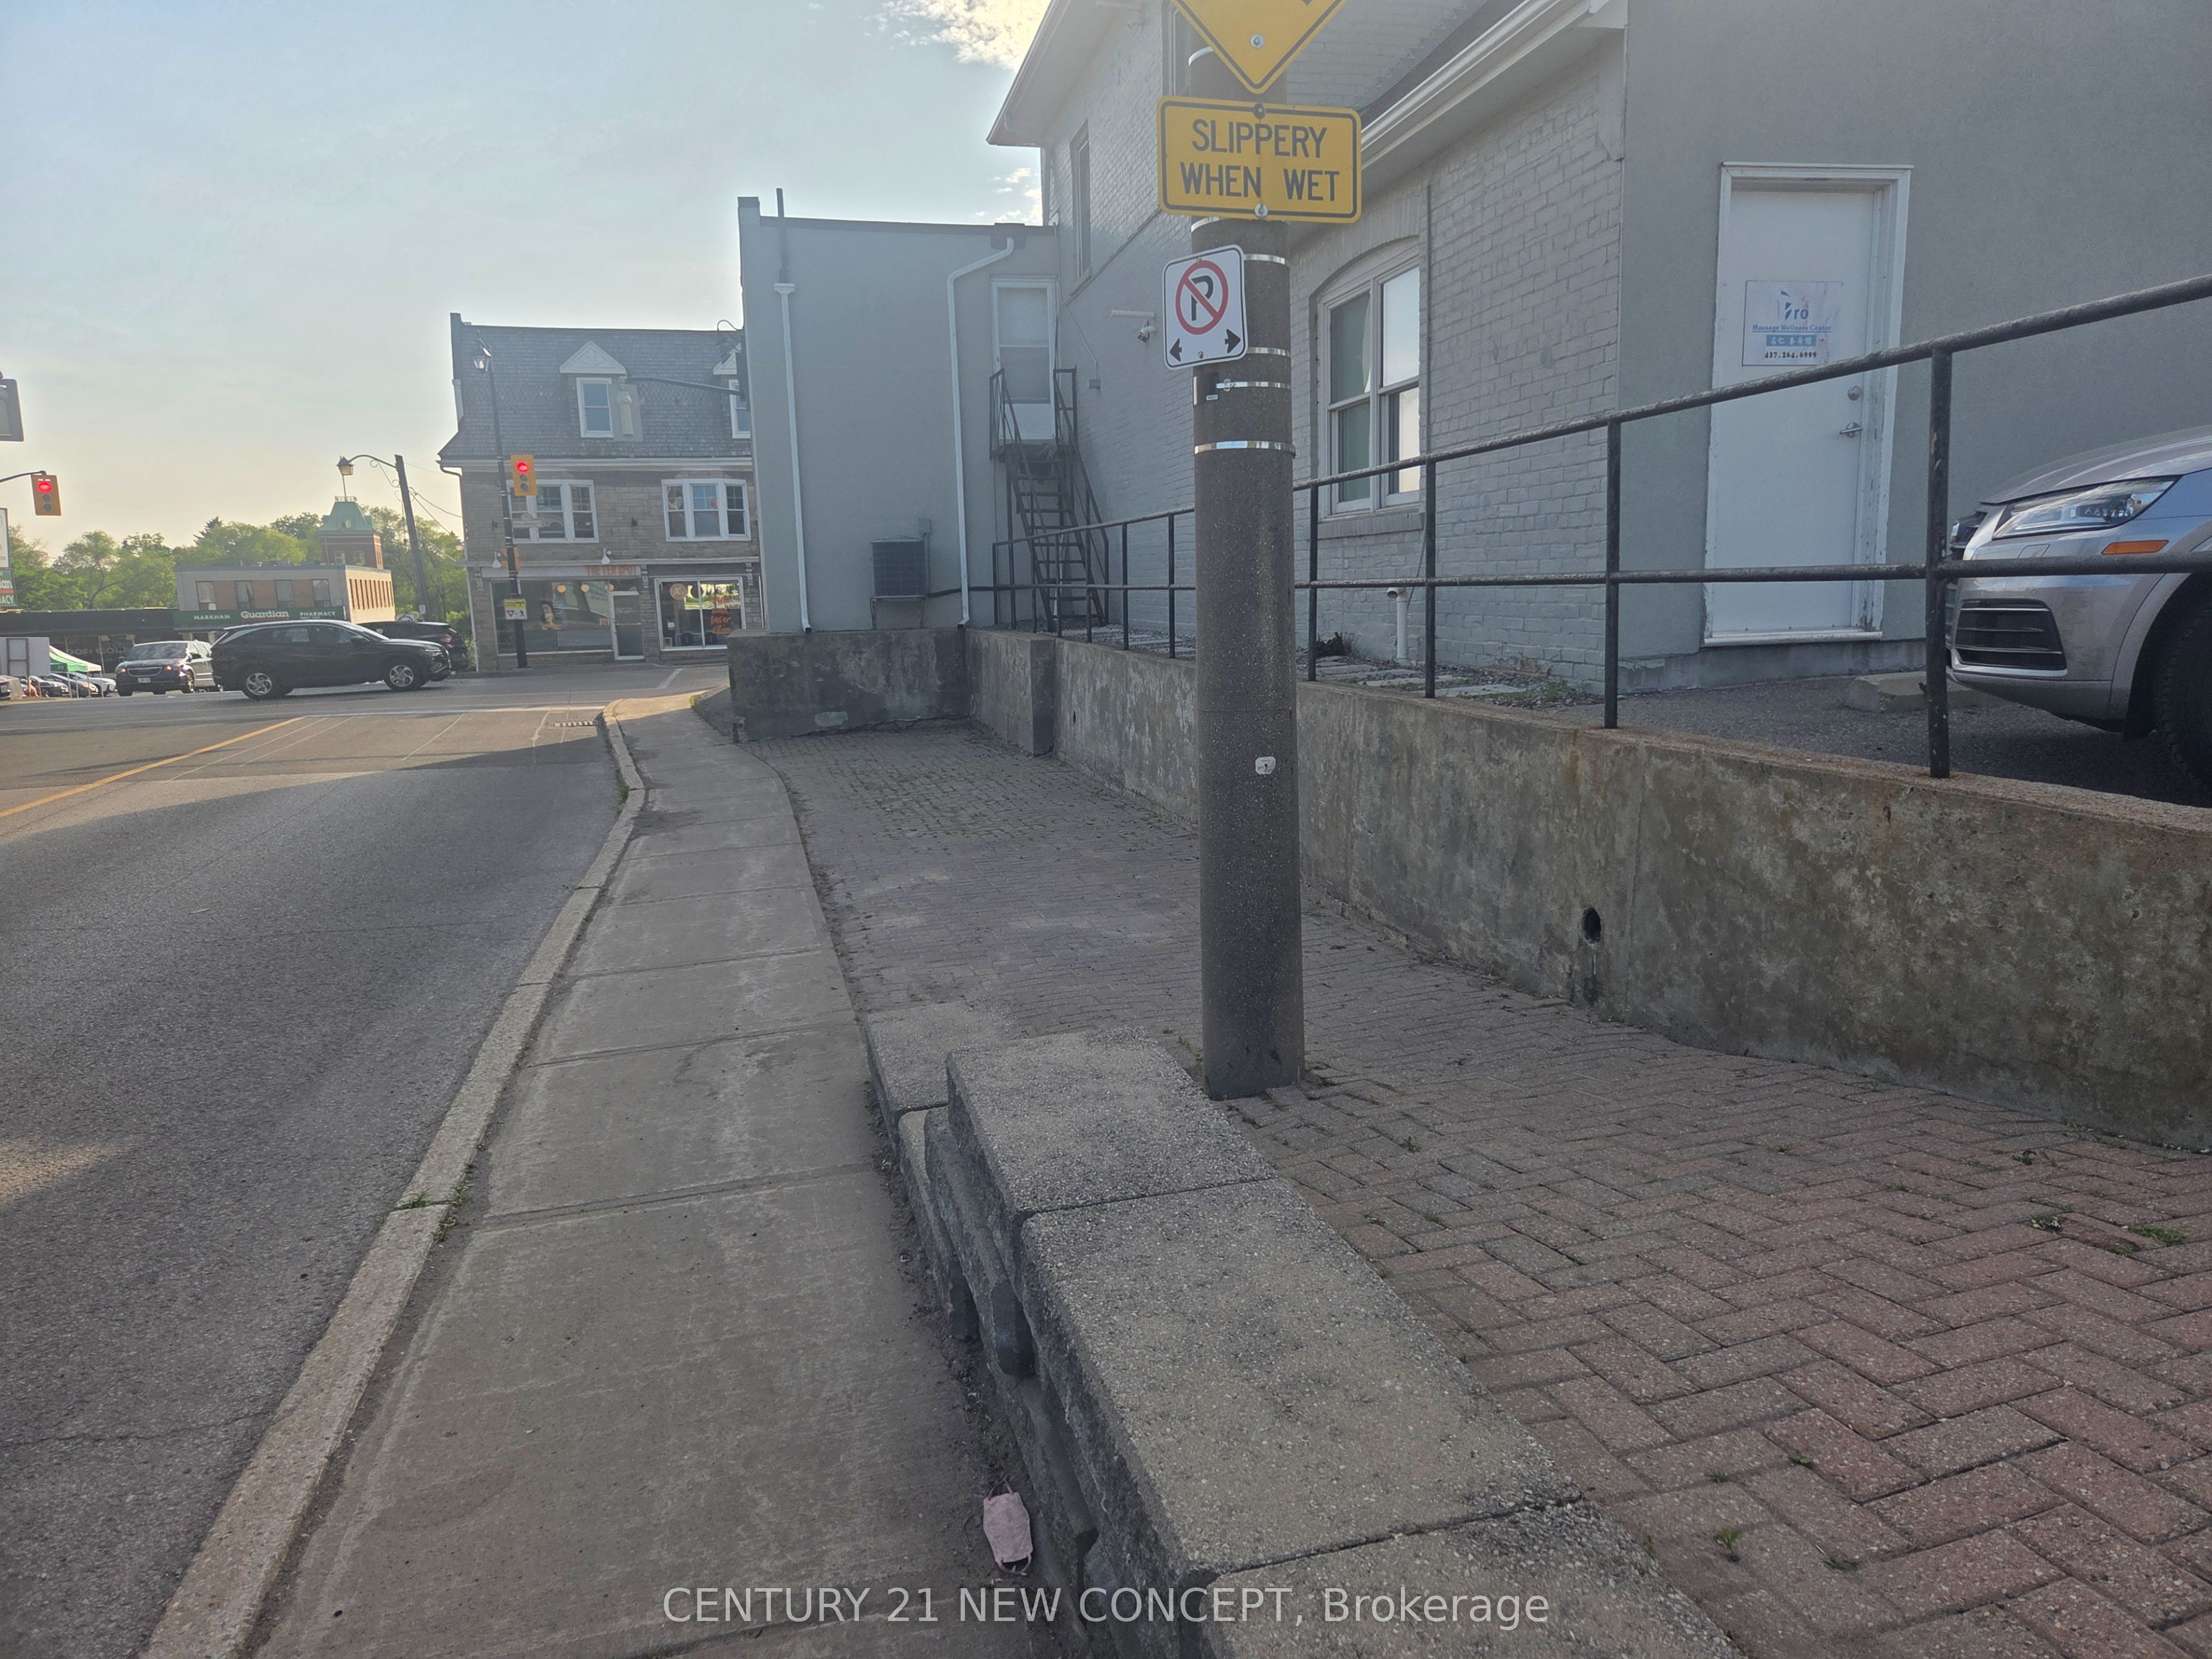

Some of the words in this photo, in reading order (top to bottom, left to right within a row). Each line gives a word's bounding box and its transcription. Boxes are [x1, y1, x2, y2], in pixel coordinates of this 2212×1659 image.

[1192, 119, 1327, 158] SLIPPERY
[1180, 162, 1261, 198] WHEN
[1283, 169, 1340, 202] WET
